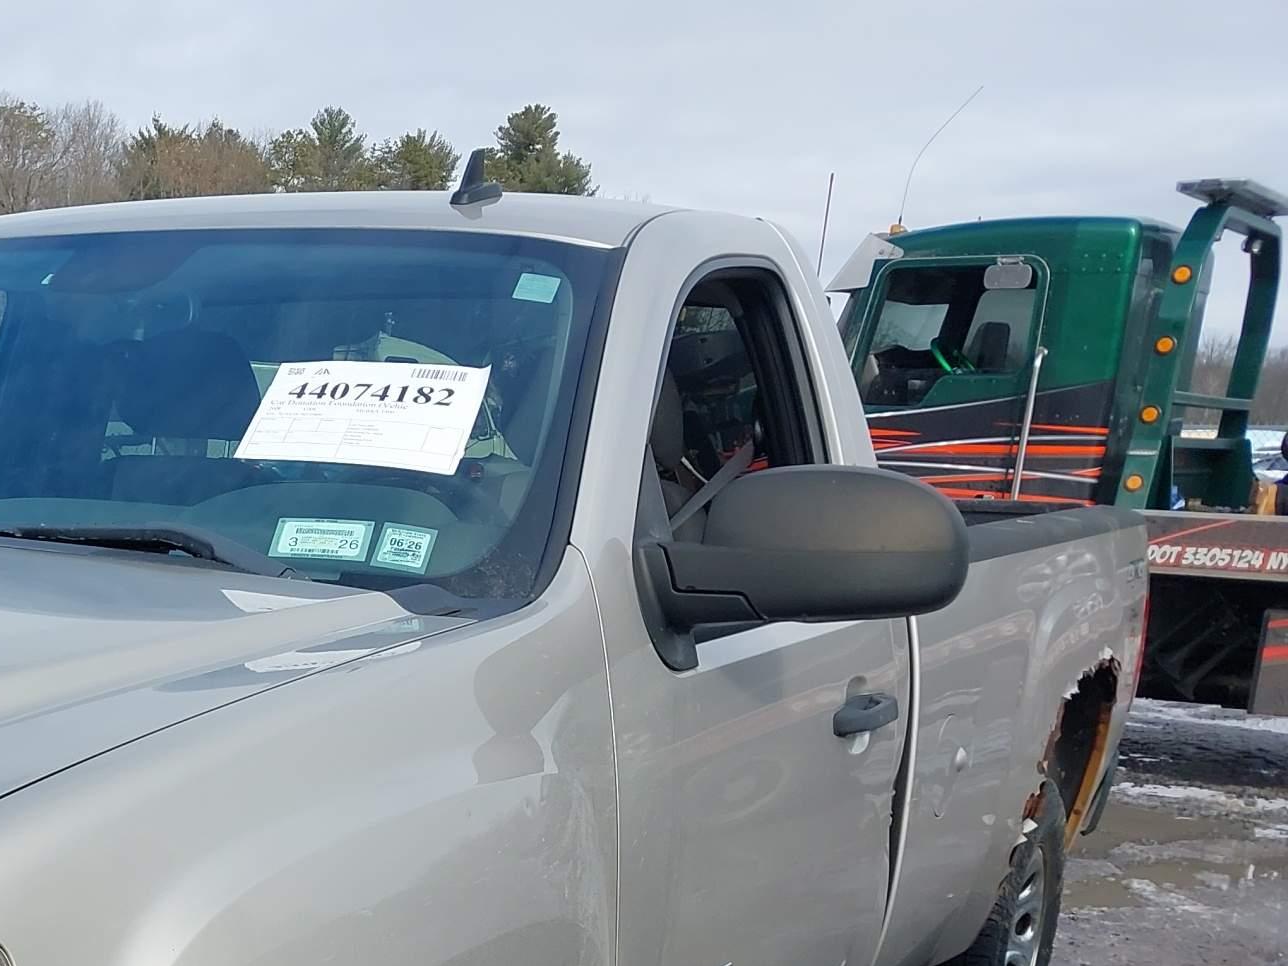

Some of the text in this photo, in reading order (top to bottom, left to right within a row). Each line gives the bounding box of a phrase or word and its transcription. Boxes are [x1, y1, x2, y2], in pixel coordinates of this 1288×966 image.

[288, 381, 455, 406] 44074182
[288, 536, 299, 547] 3
[337, 539, 360, 550] 26
[389, 537, 423, 550] 06 26
[1147, 545, 1182, 564] DOT
[1182, 546, 1265, 568] 3305124
